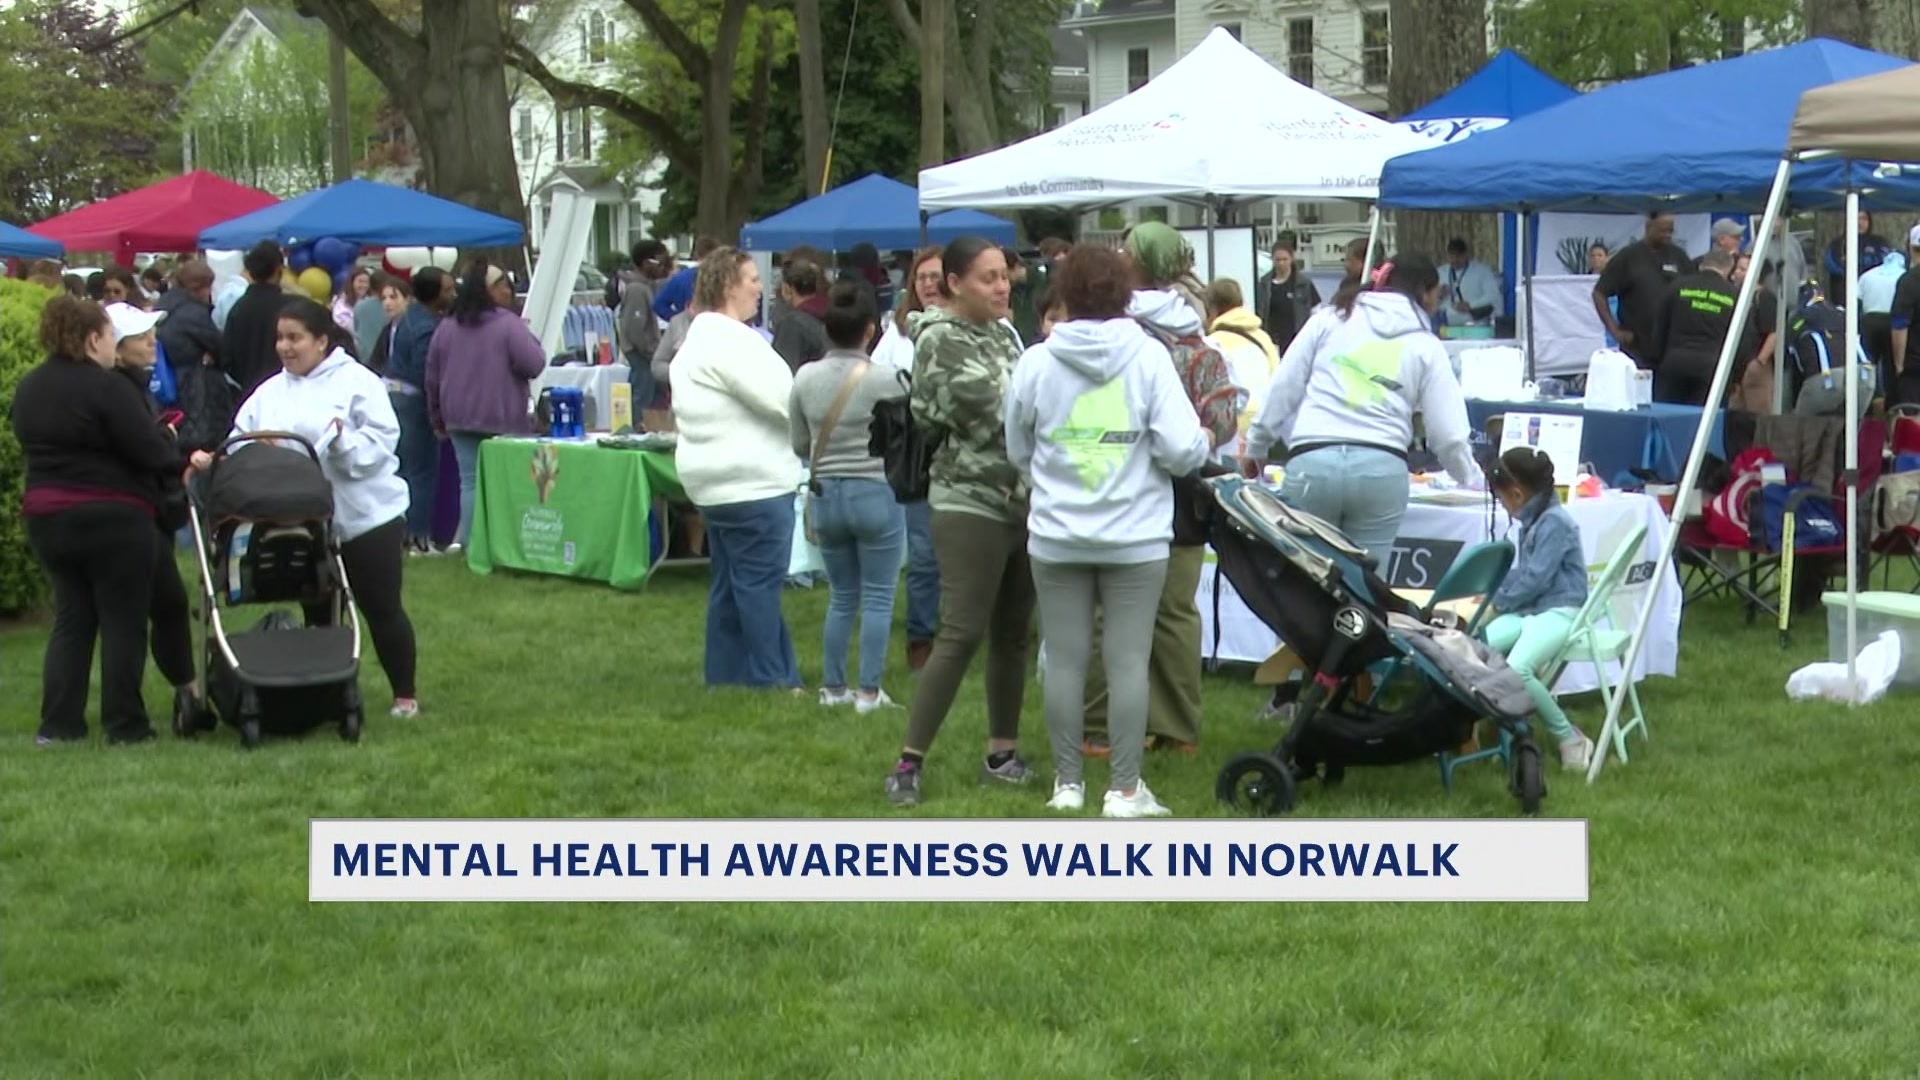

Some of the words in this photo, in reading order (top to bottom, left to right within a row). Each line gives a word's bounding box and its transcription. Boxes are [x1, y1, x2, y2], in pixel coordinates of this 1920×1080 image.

[1020, 181, 1038, 196] the
[1039, 177, 1105, 196] Community
[1335, 174, 1355, 188] the
[1680, 288, 1707, 298] Mental
[1708, 291, 1734, 306] Health
